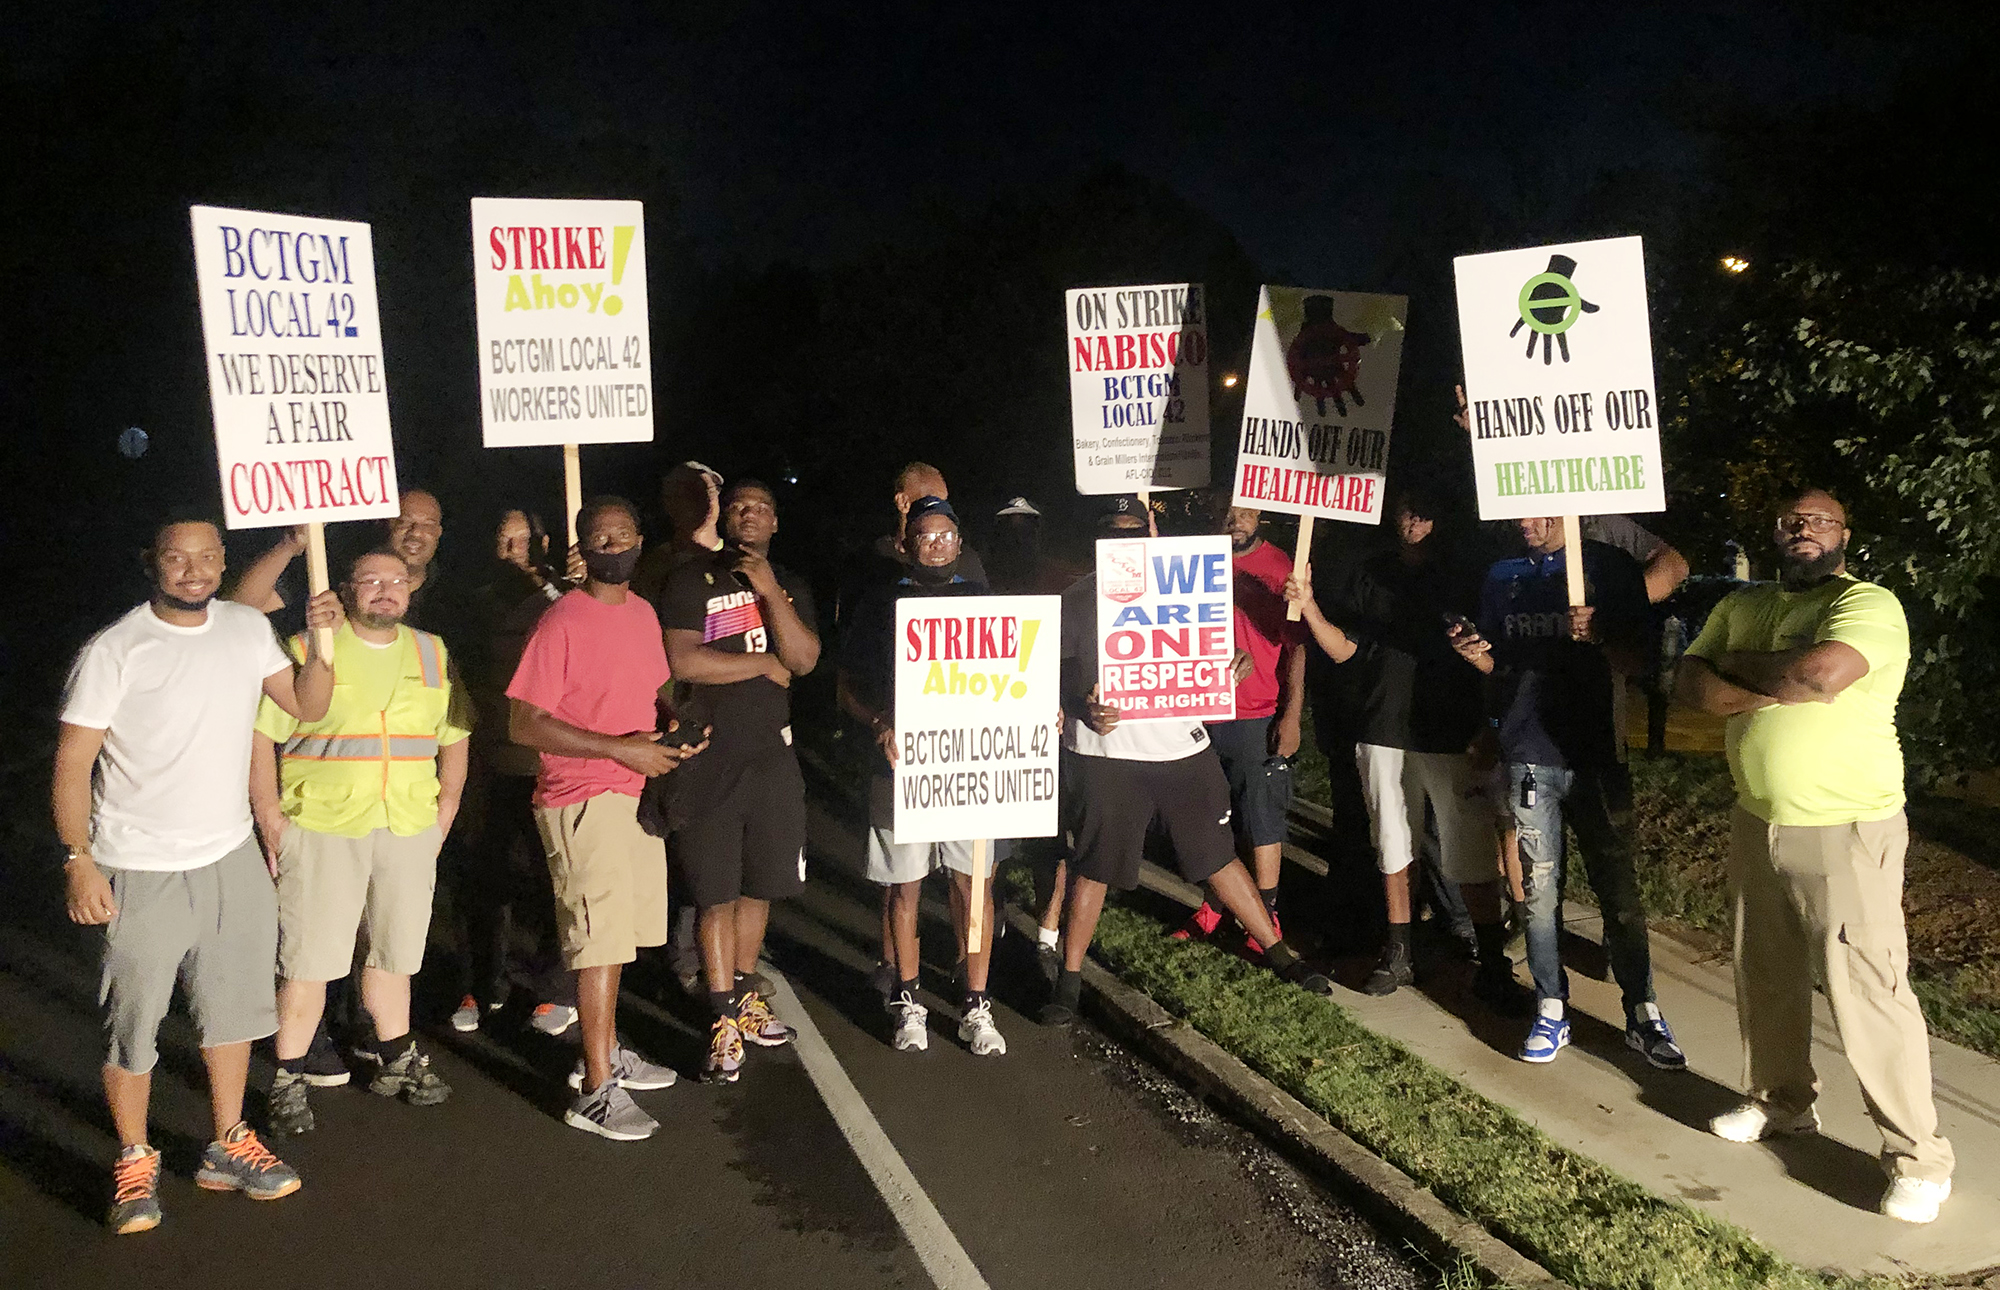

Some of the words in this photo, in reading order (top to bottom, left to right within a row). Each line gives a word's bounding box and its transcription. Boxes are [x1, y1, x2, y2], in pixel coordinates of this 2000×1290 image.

[219, 226, 353, 284] BCTGM
[490, 226, 606, 270] STRIKE
[226, 289, 321, 338] LOCAL
[327, 292, 358, 338] 42
[1076, 293, 1107, 331] ON
[1117, 288, 1200, 329] STRIKE
[491, 338, 555, 375] BCTGM
[560, 338, 618, 373] LOCAL
[622, 336, 641, 369] 42
[1074, 331, 1206, 372] NABISCO
[217, 353, 265, 395] WE
[267, 353, 382, 395] DESERVE
[1103, 373, 1181, 401] BCTGM
[266, 401, 285, 444] A
[287, 401, 354, 444] FAIR
[490, 385, 581, 423] WORKERS
[586, 383, 648, 418] UNITED
[1102, 402, 1157, 429] LOCAL
[1163, 400, 1186, 424] 42
[1474, 396, 1545, 439] HANDS
[1554, 392, 1593, 434] OFF
[1605, 389, 1652, 430] OUR
[1076, 438, 1101, 451] Bakery,
[1102, 435, 1150, 449] Confectionery,
[1088, 456, 1093, 466] &
[1095, 454, 1114, 466] Grain
[1115, 453, 1138, 465] Millers
[1243, 416, 1304, 460] HANDS
[1308, 424, 1343, 464] OFF
[1346, 427, 1386, 470] OUR
[230, 456, 390, 516] CONTRACT
[1240, 464, 1376, 513] HEALTHCARE
[1495, 455, 1646, 496] HEALTHCARE
[1152, 553, 1228, 595] WE
[1112, 602, 1228, 627] ARE
[1505, 612, 1571, 638] FRAN
[745, 626, 767, 653] 13
[906, 616, 1018, 662] STRIKE
[1105, 626, 1228, 660] ONE
[1104, 660, 1230, 692] RESPECT
[1105, 696, 1149, 711] OUR
[1154, 691, 1232, 709] RIGHTS
[904, 727, 965, 766] BCTGM
[971, 723, 1027, 760] LOCAL
[1031, 724, 1049, 758] 42
[902, 773, 989, 810] WORKERS
[995, 767, 1054, 804] UNITED
